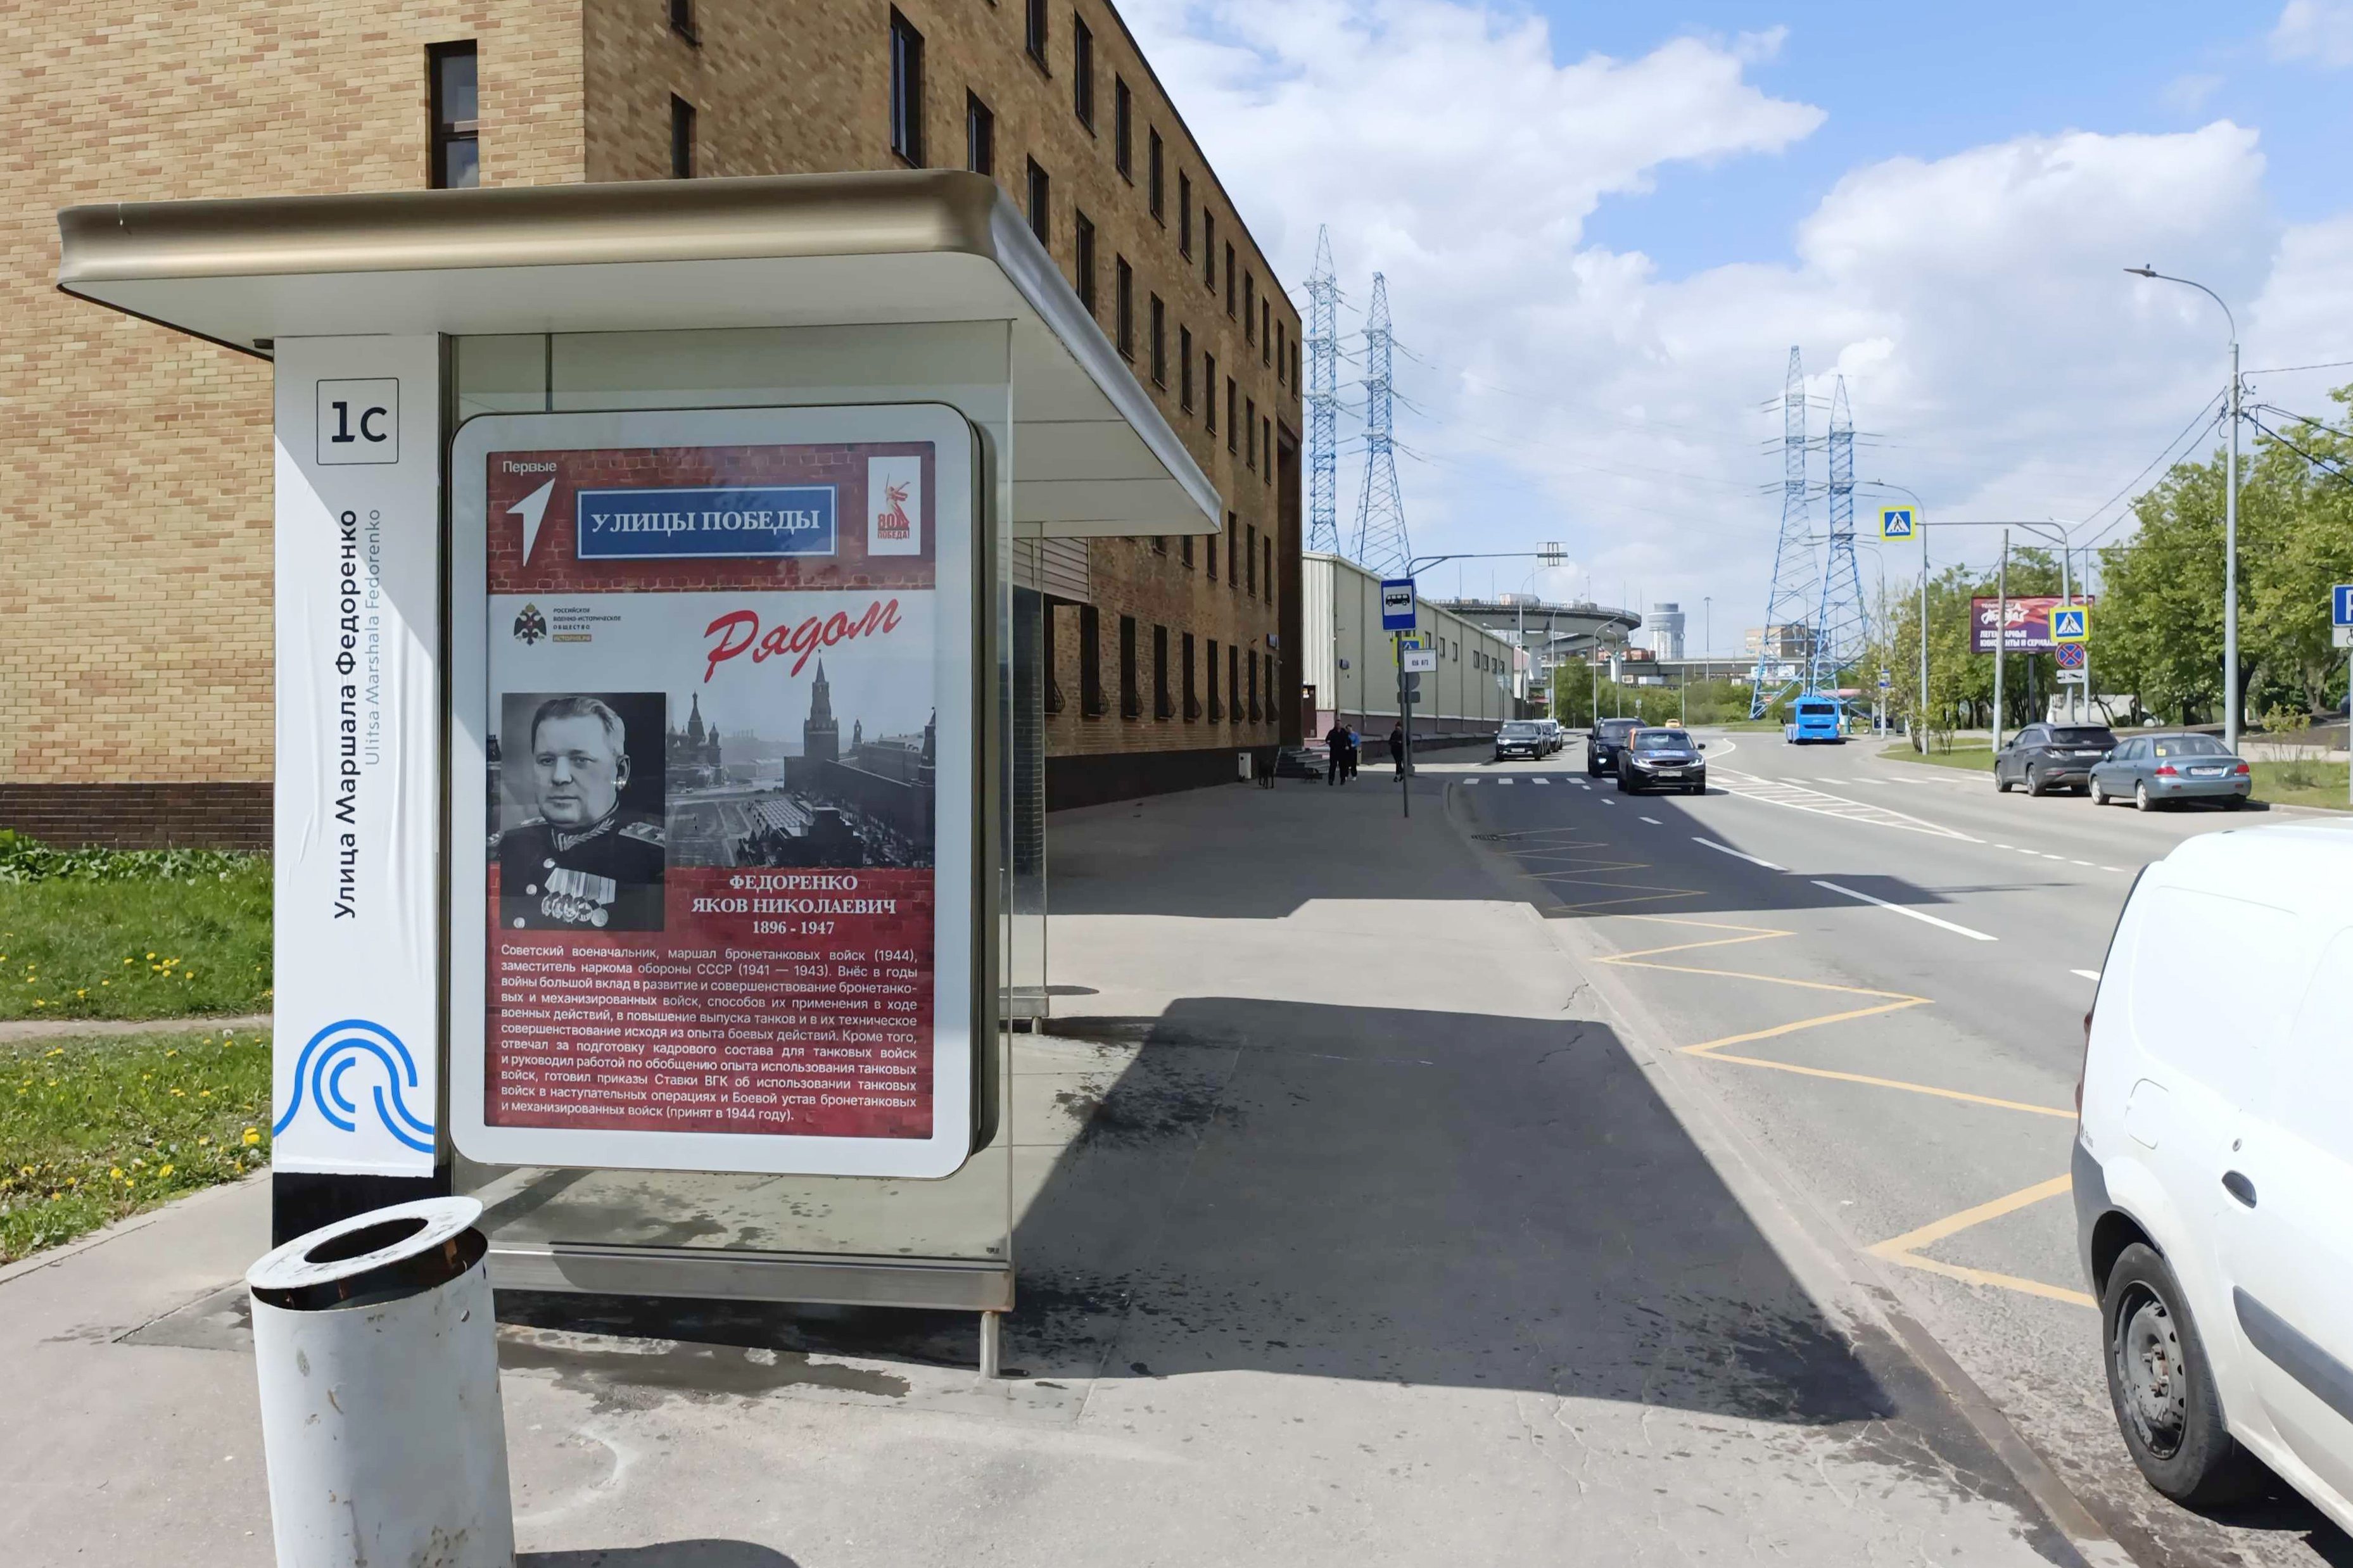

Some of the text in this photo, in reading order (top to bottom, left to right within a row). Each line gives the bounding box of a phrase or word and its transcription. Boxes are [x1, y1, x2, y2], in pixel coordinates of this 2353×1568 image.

[502, 460, 557, 476] Первые
[590, 510, 820, 538] УЛИЦЫ ПОБЕДЫ
[364, 509, 380, 765] Ulitsa Marshala Fedorenko
[704, 598, 902, 683] Рядом
[1980, 629, 2027, 638] ЛЕГЕАРНЫЕ
[1980, 639, 2020, 647] КИНОНТЫ
[334, 510, 361, 919] Улица Маршала Федоренко
[729, 875, 858, 894] ФЕДОРЕНКО
[691, 897, 897, 914] ЯКОВ НИКОЛАЕВИЧ
[752, 921, 787, 934] 1896
[800, 921, 835, 935] 1947
[500, 944, 917, 963] Советский военачальник, маршал бронетанковых войск (1944),
[500, 961, 576, 972] заместитель
[580, 963, 633, 975] наркома
[637, 961, 692, 976] обороны
[696, 962, 732, 975] СССР
[738, 963, 769, 977] (1941
[793, 964, 831, 978] 1943).
[837, 964, 868, 977] Внёс
[873, 967, 880, 977] в
[885, 968, 917, 980] годы
[500, 974, 917, 995] войны большой вклад в развитие и совершенствование бронетанко-
[500, 992, 917, 1012] вых и механизированных войск, способов их применения в ходе
[501, 1007, 917, 1026] военных действий, в повышение выпуска танков и в их техническое
[500, 1024, 916, 1044] совершенствование исходя из опыта боевых действий. Кроме того,
[500, 1040, 917, 1059] отвечал за подготовку кадрового состава для танковых войск
[500, 1054, 916, 1075] и руководил работой по обобщению опыта использования танковых
[500, 1068, 916, 1091] войск, готовил приказы Ставки ВГК об использовании танковых
[500, 1084, 916, 1110] войск в наступательных операциях и Боевой устав бронетанковых
[500, 1101, 794, 1122] и механизированных войск (принят в 1944 году).
